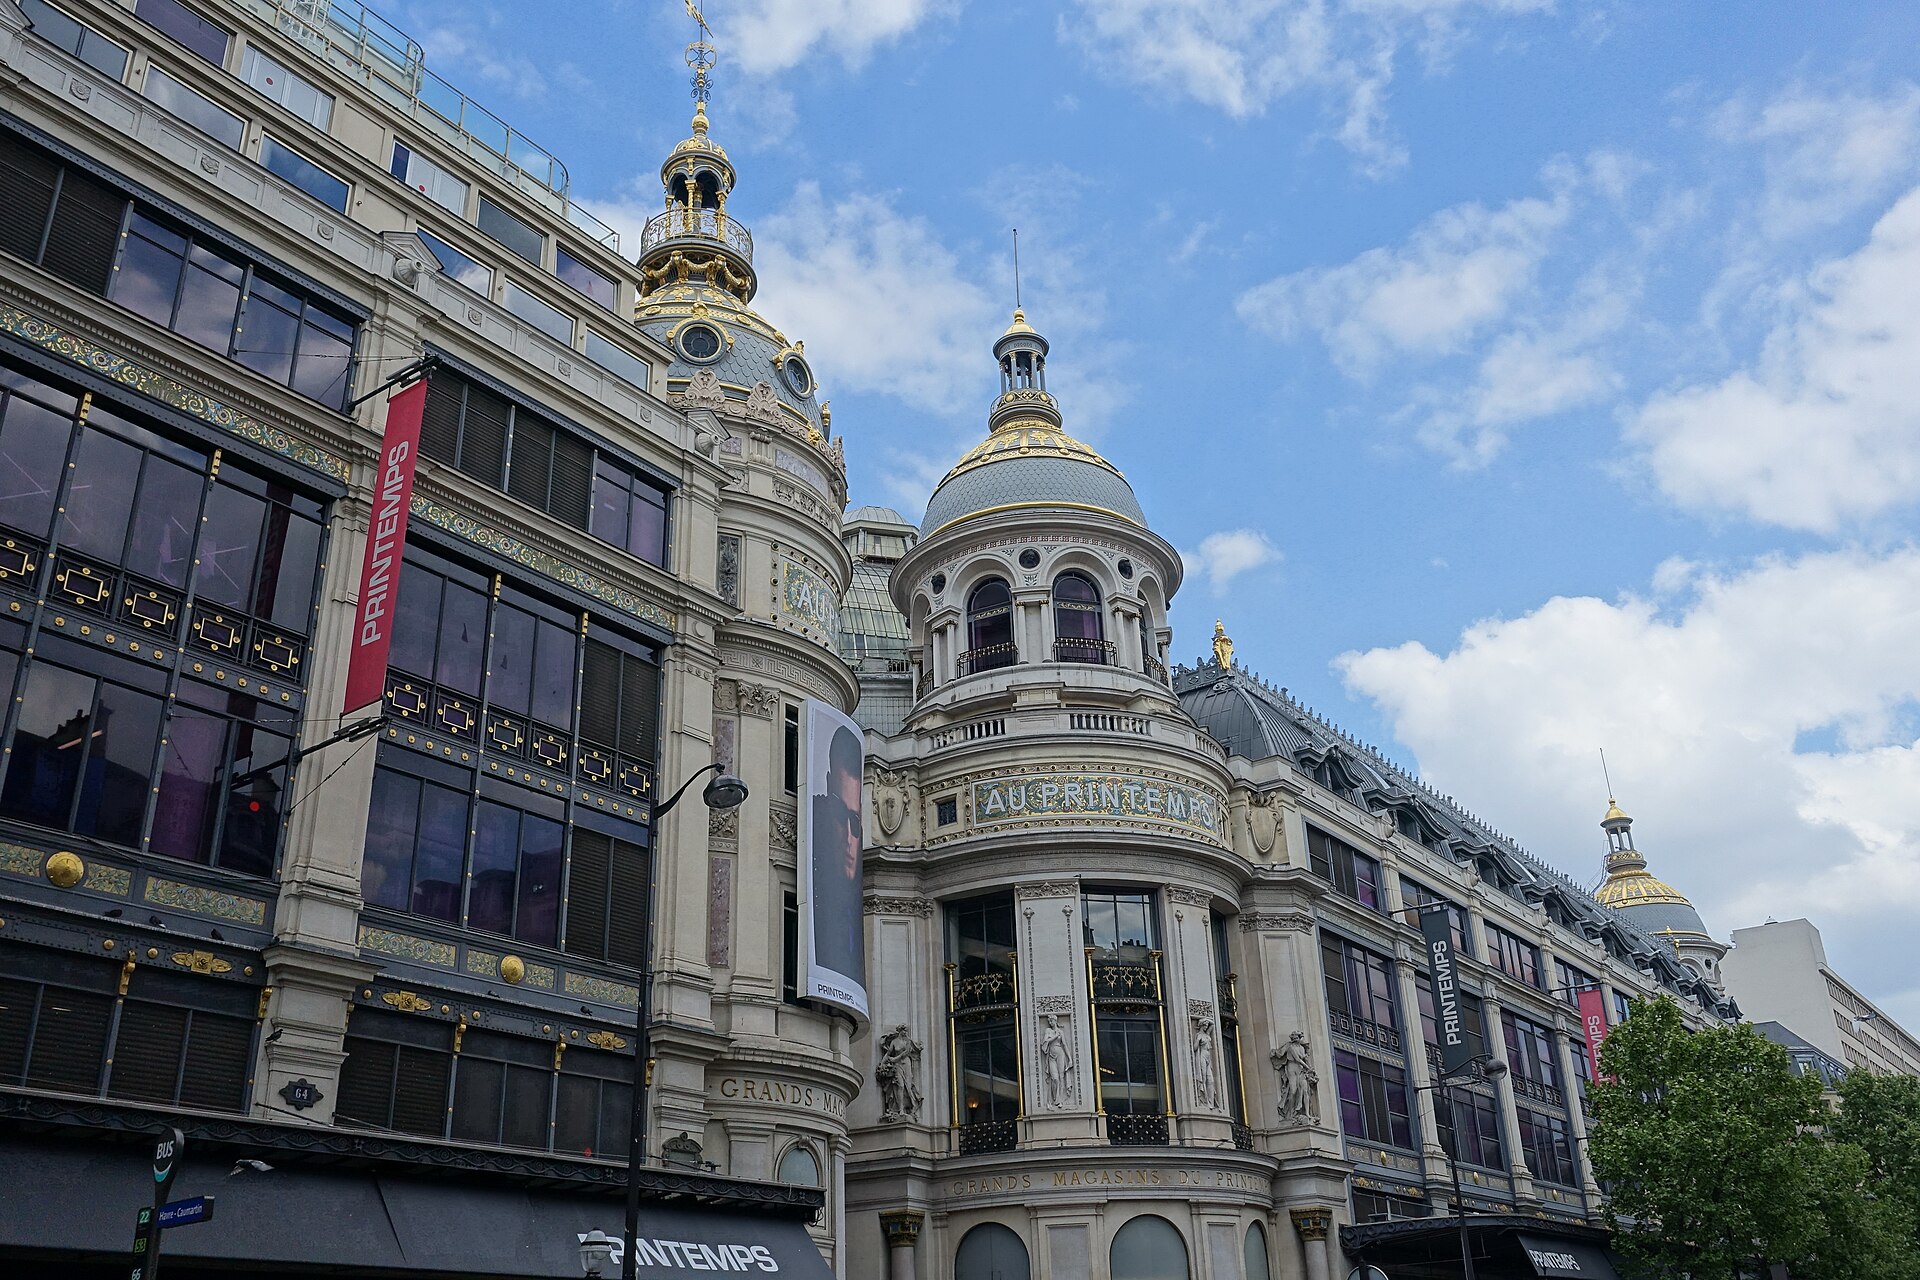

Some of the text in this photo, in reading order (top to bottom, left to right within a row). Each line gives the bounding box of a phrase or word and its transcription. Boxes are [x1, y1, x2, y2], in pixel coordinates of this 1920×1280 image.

[361, 440, 409, 646] PRINTEMPS
[797, 581, 826, 622] AU
[984, 781, 1213, 828] AU PRINTEMPS
[817, 983, 855, 1005] PRINTEMPS
[1432, 940, 1462, 1046] PRINTEMPS
[295, 1088, 308, 1100] 64
[720, 1078, 813, 1107] GRANDS
[156, 1140, 175, 1160] BUS
[953, 1174, 1031, 1196] GRANDS
[1053, 1169, 1161, 1187] MAGASINS
[1179, 1170, 1201, 1186] DU
[139, 1211, 150, 1224] 22
[176, 1203, 203, 1218] Caumartin
[1529, 1249, 1581, 1271] PRINTEMPS
[131, 1268, 141, 1280] 66
